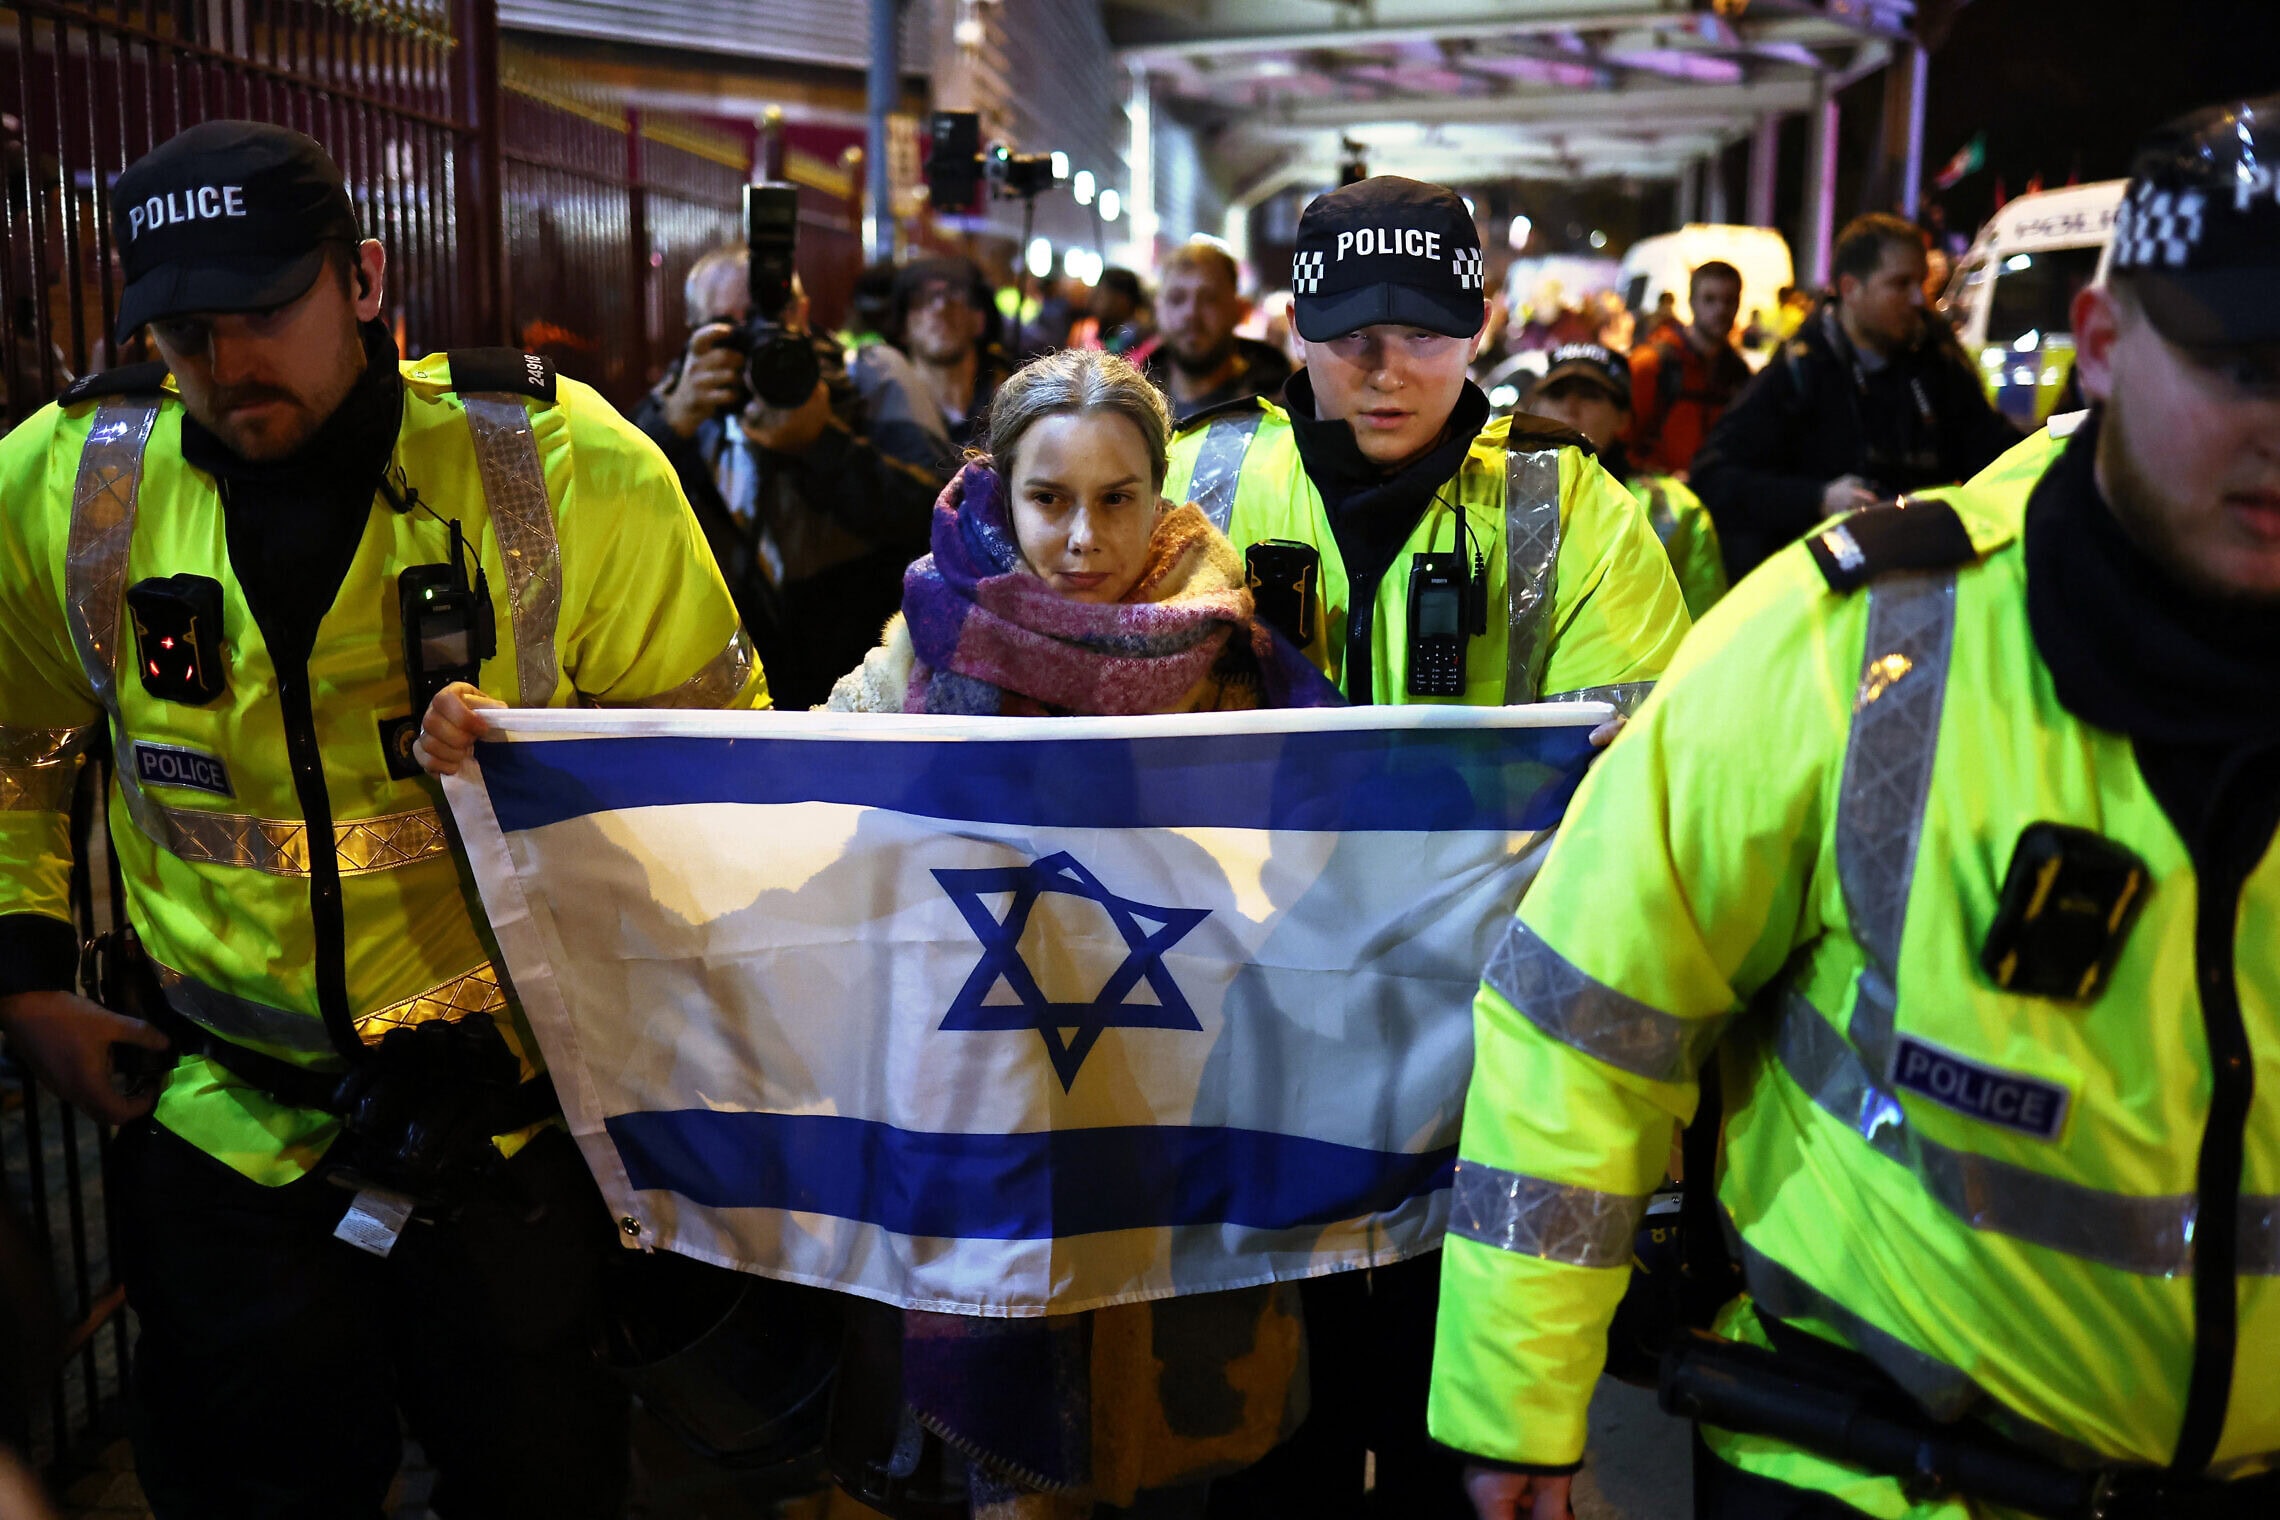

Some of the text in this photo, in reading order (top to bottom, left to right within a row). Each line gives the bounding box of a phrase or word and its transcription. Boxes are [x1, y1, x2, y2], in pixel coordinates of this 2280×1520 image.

[129, 186, 247, 241] POLICE
[1336, 228, 1441, 261] POLICE
[523, 354, 545, 387] 24918
[142, 752, 225, 788] POLICE
[1904, 1050, 2043, 1126] POLICE
